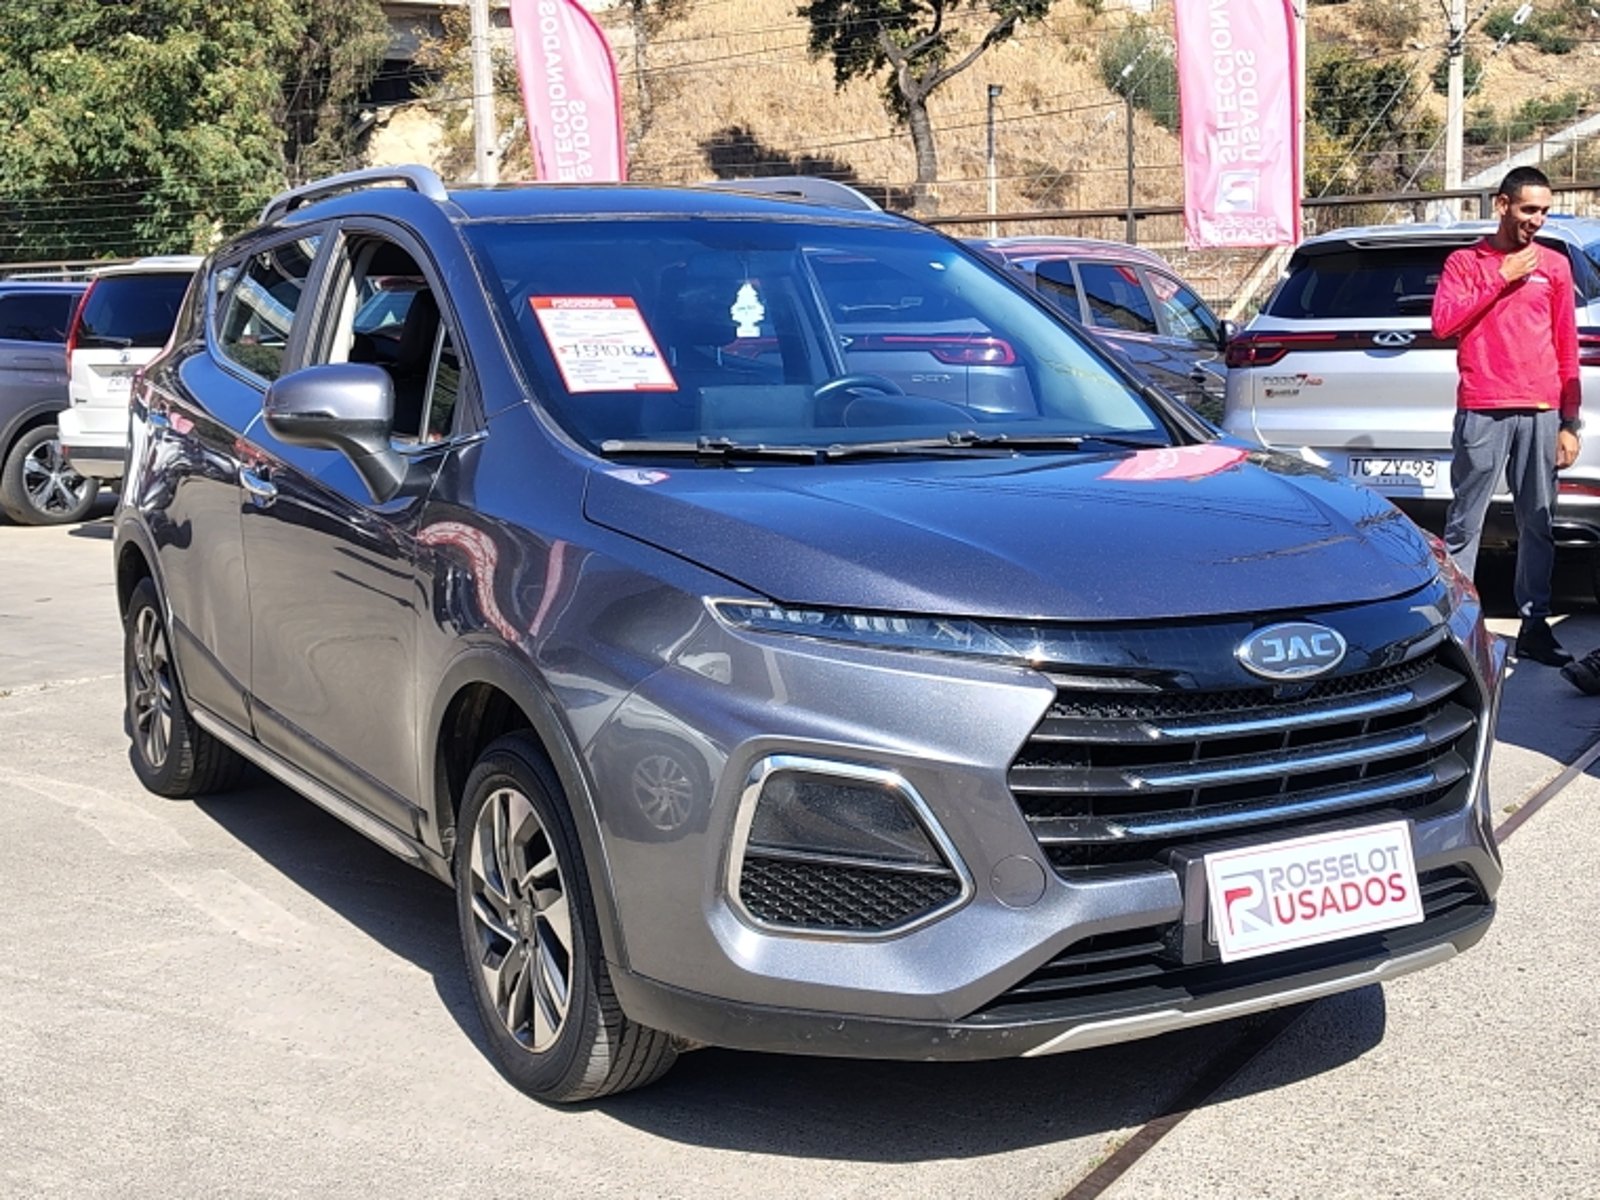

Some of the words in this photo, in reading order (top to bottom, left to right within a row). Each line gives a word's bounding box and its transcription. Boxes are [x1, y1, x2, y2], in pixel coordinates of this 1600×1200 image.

[1262, 632, 1335, 663] JAC
[1269, 846, 1399, 893] ROSSELOT
[1273, 873, 1407, 924] USADOS
